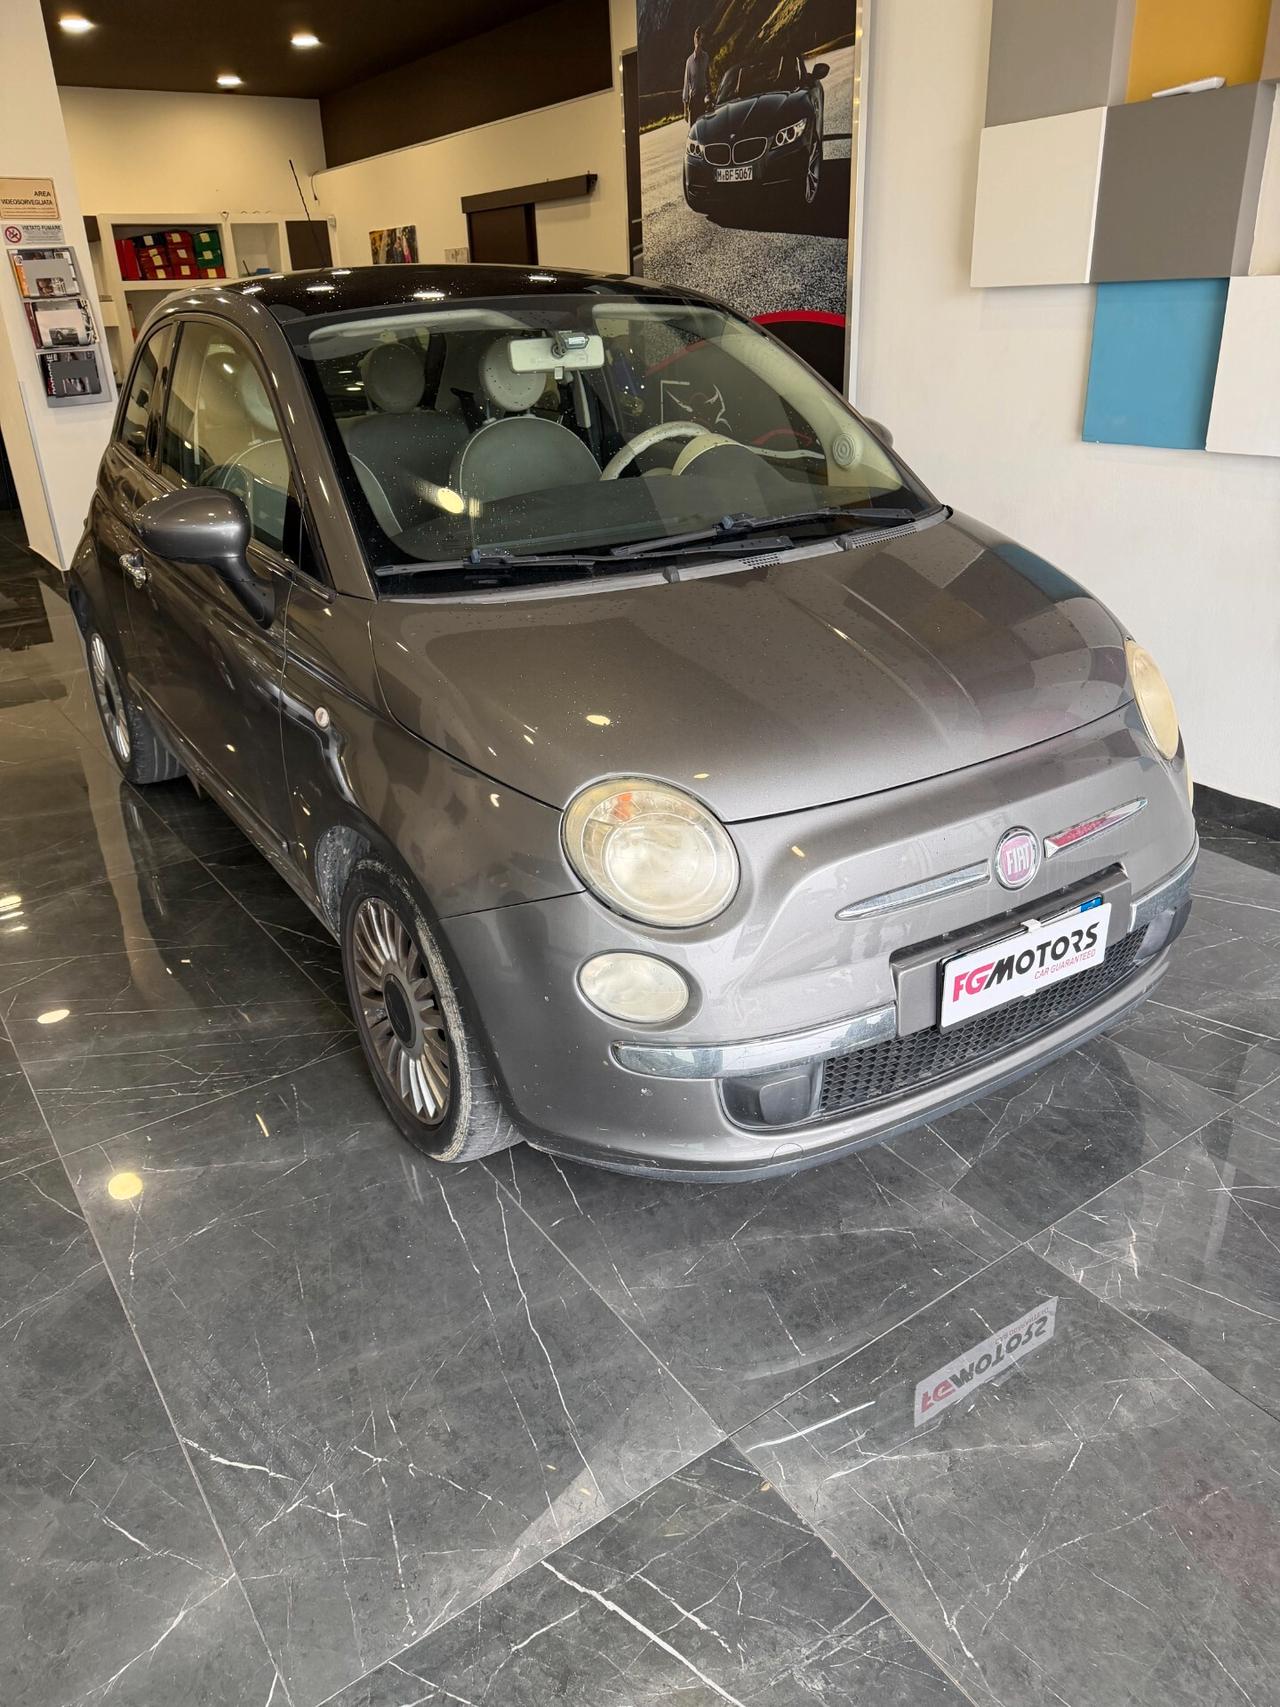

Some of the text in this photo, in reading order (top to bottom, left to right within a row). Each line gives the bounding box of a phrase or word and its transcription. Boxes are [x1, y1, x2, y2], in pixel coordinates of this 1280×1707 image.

[735, 168, 752, 180] 5067
[1006, 843, 1029, 876] FIAT
[1034, 948, 1096, 980] CAR GUARANTEED
